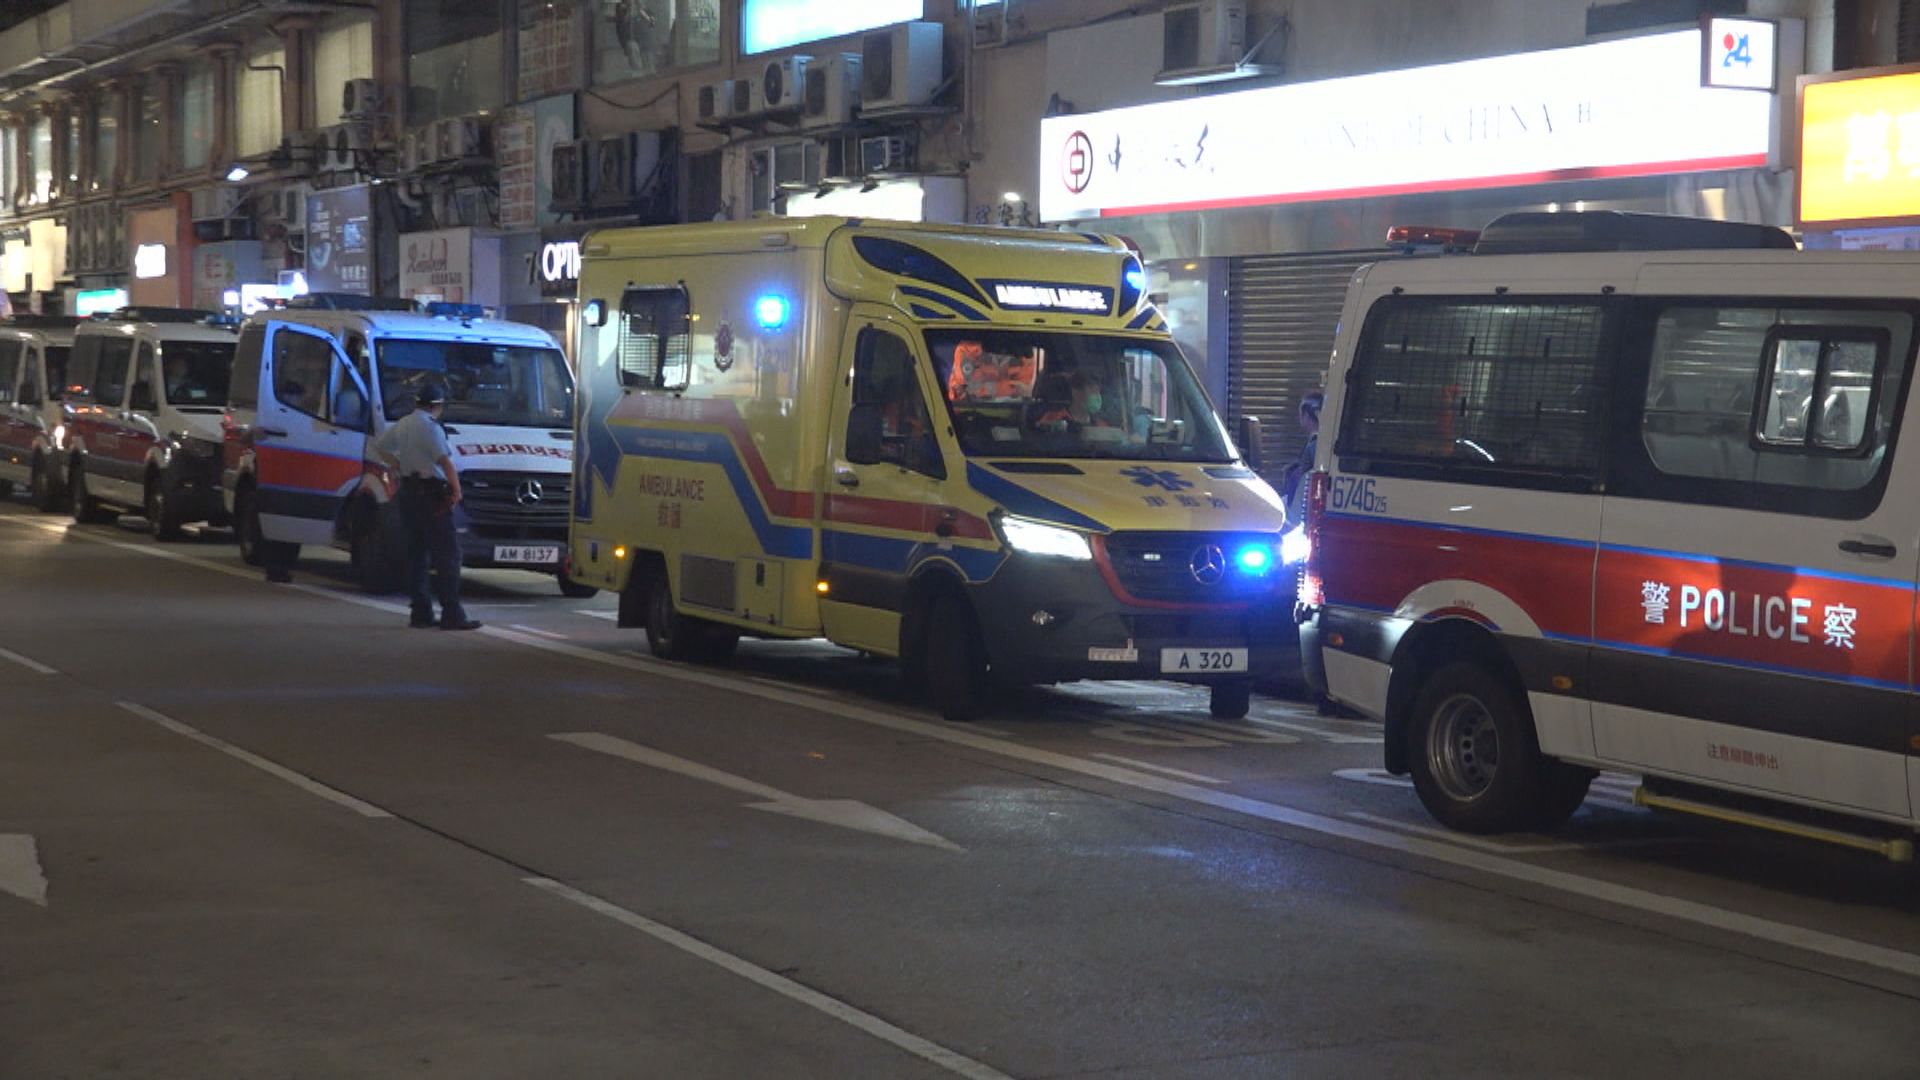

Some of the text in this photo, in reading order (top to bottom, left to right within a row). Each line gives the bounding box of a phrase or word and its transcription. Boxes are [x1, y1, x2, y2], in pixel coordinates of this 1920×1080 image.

[995, 283, 1107, 310] AMBULANCE
[640, 474, 705, 501] AMBULANCE
[501, 548, 518, 560] AM
[1641, 580, 1857, 649] 警 POLICE 察
[1179, 651, 1233, 669] A 320
